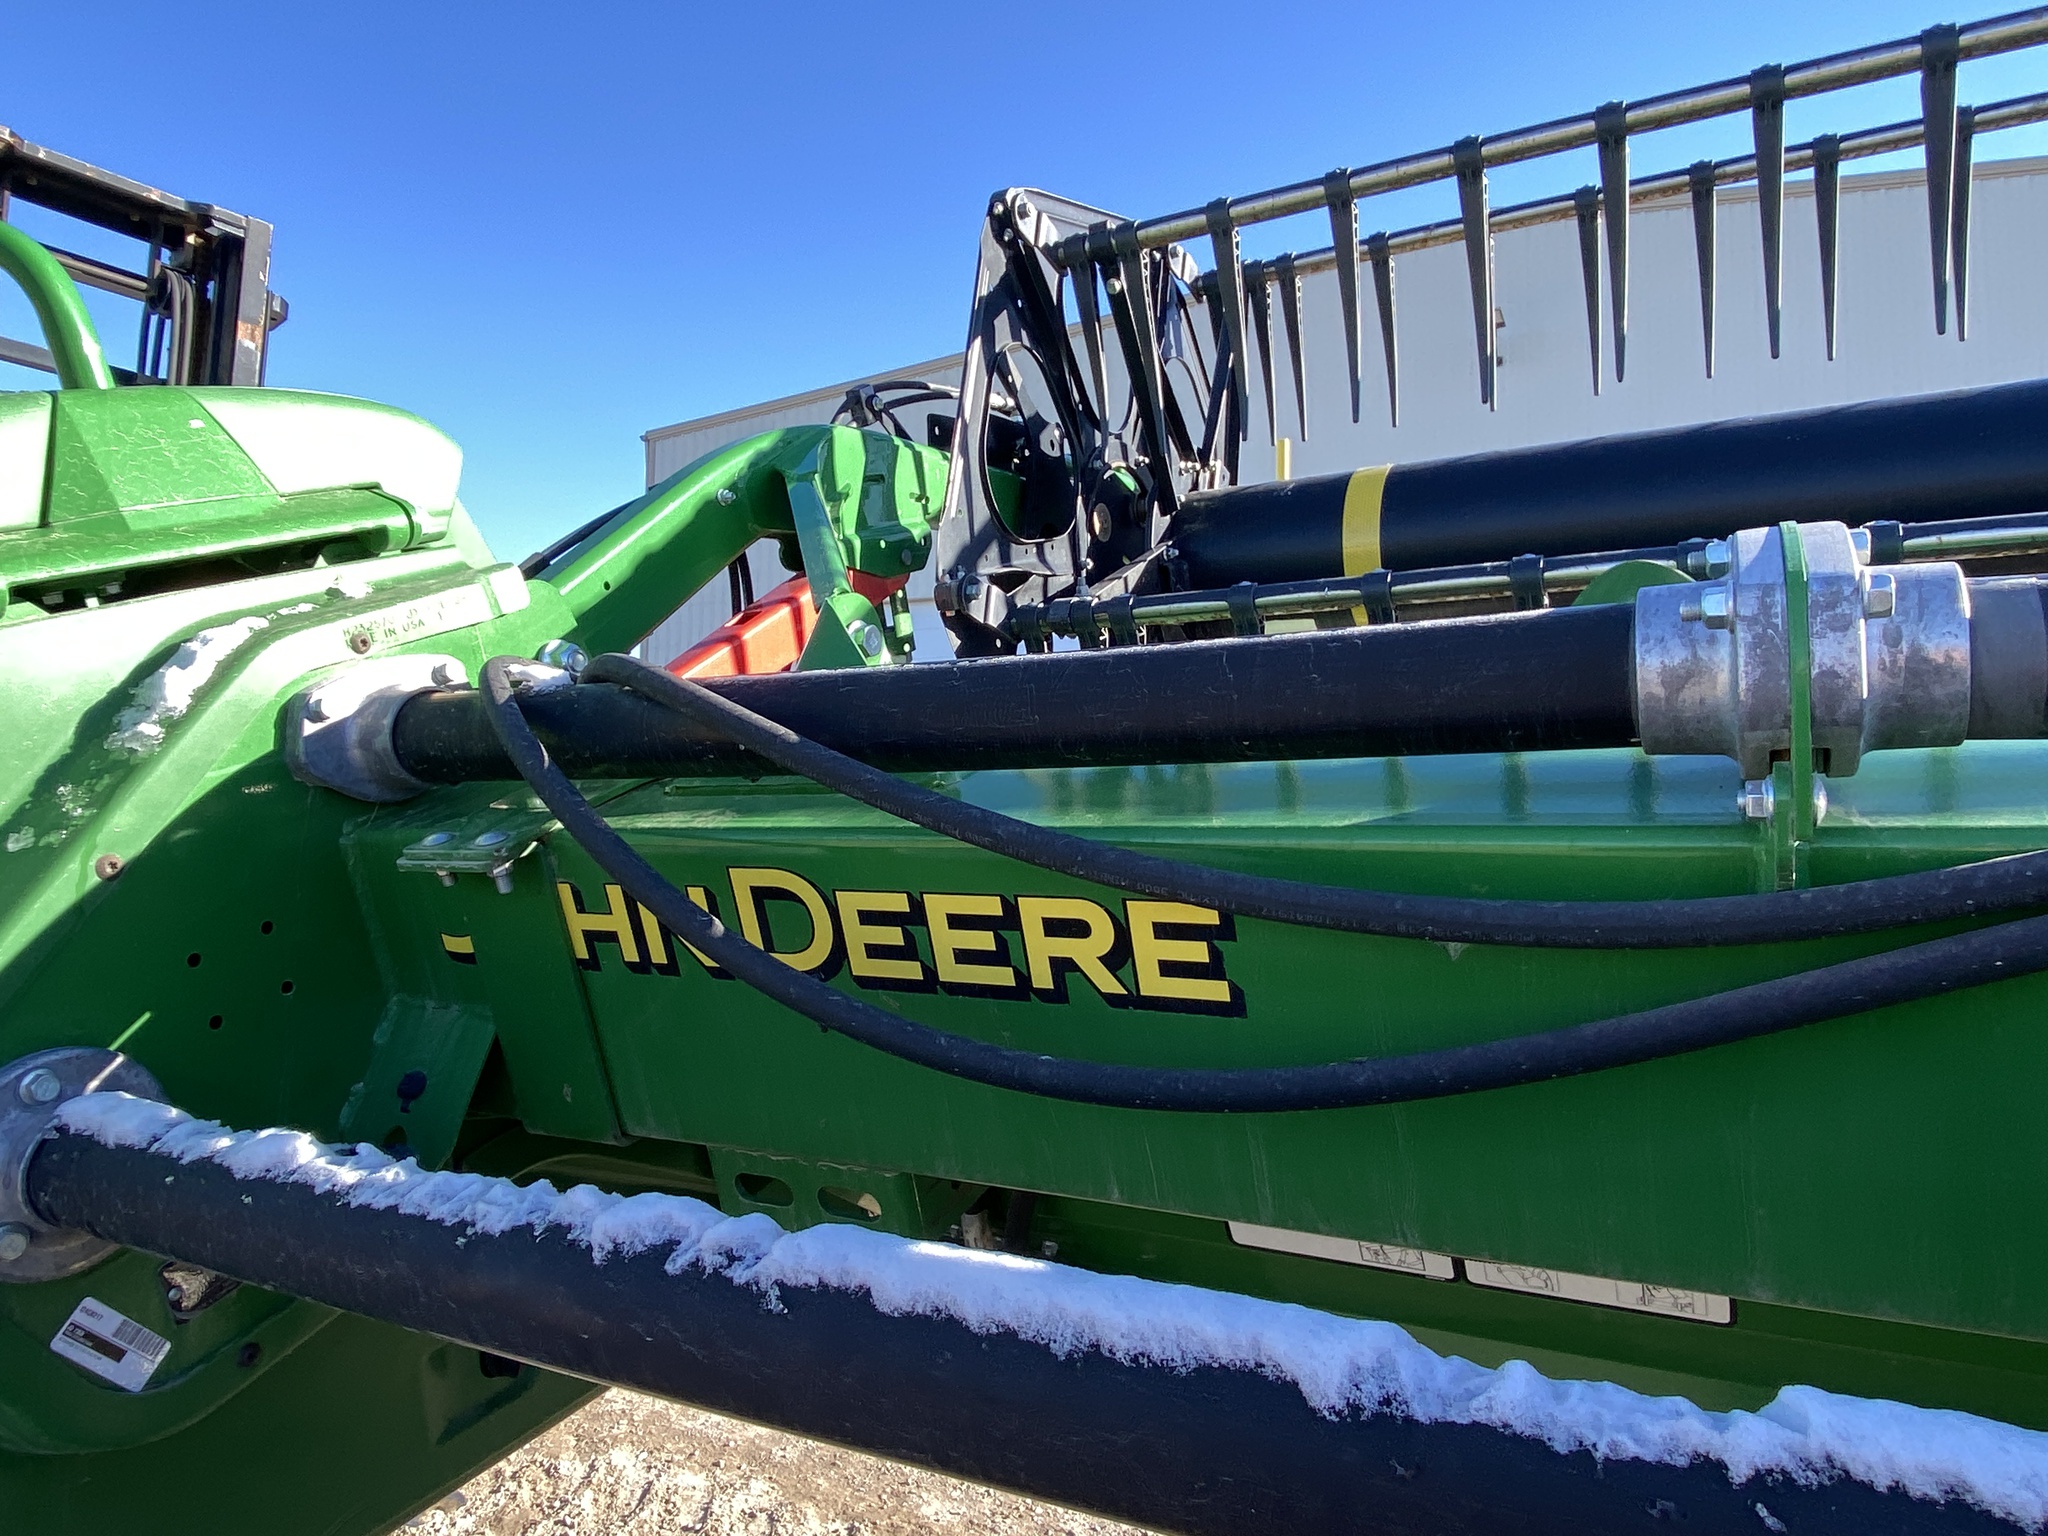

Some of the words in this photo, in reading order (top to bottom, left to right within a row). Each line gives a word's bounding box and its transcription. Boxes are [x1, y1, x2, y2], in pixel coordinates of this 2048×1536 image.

[383, 627, 398, 639] IN
[402, 619, 426, 633] USA
[727, 866, 1242, 1011] DEERE
